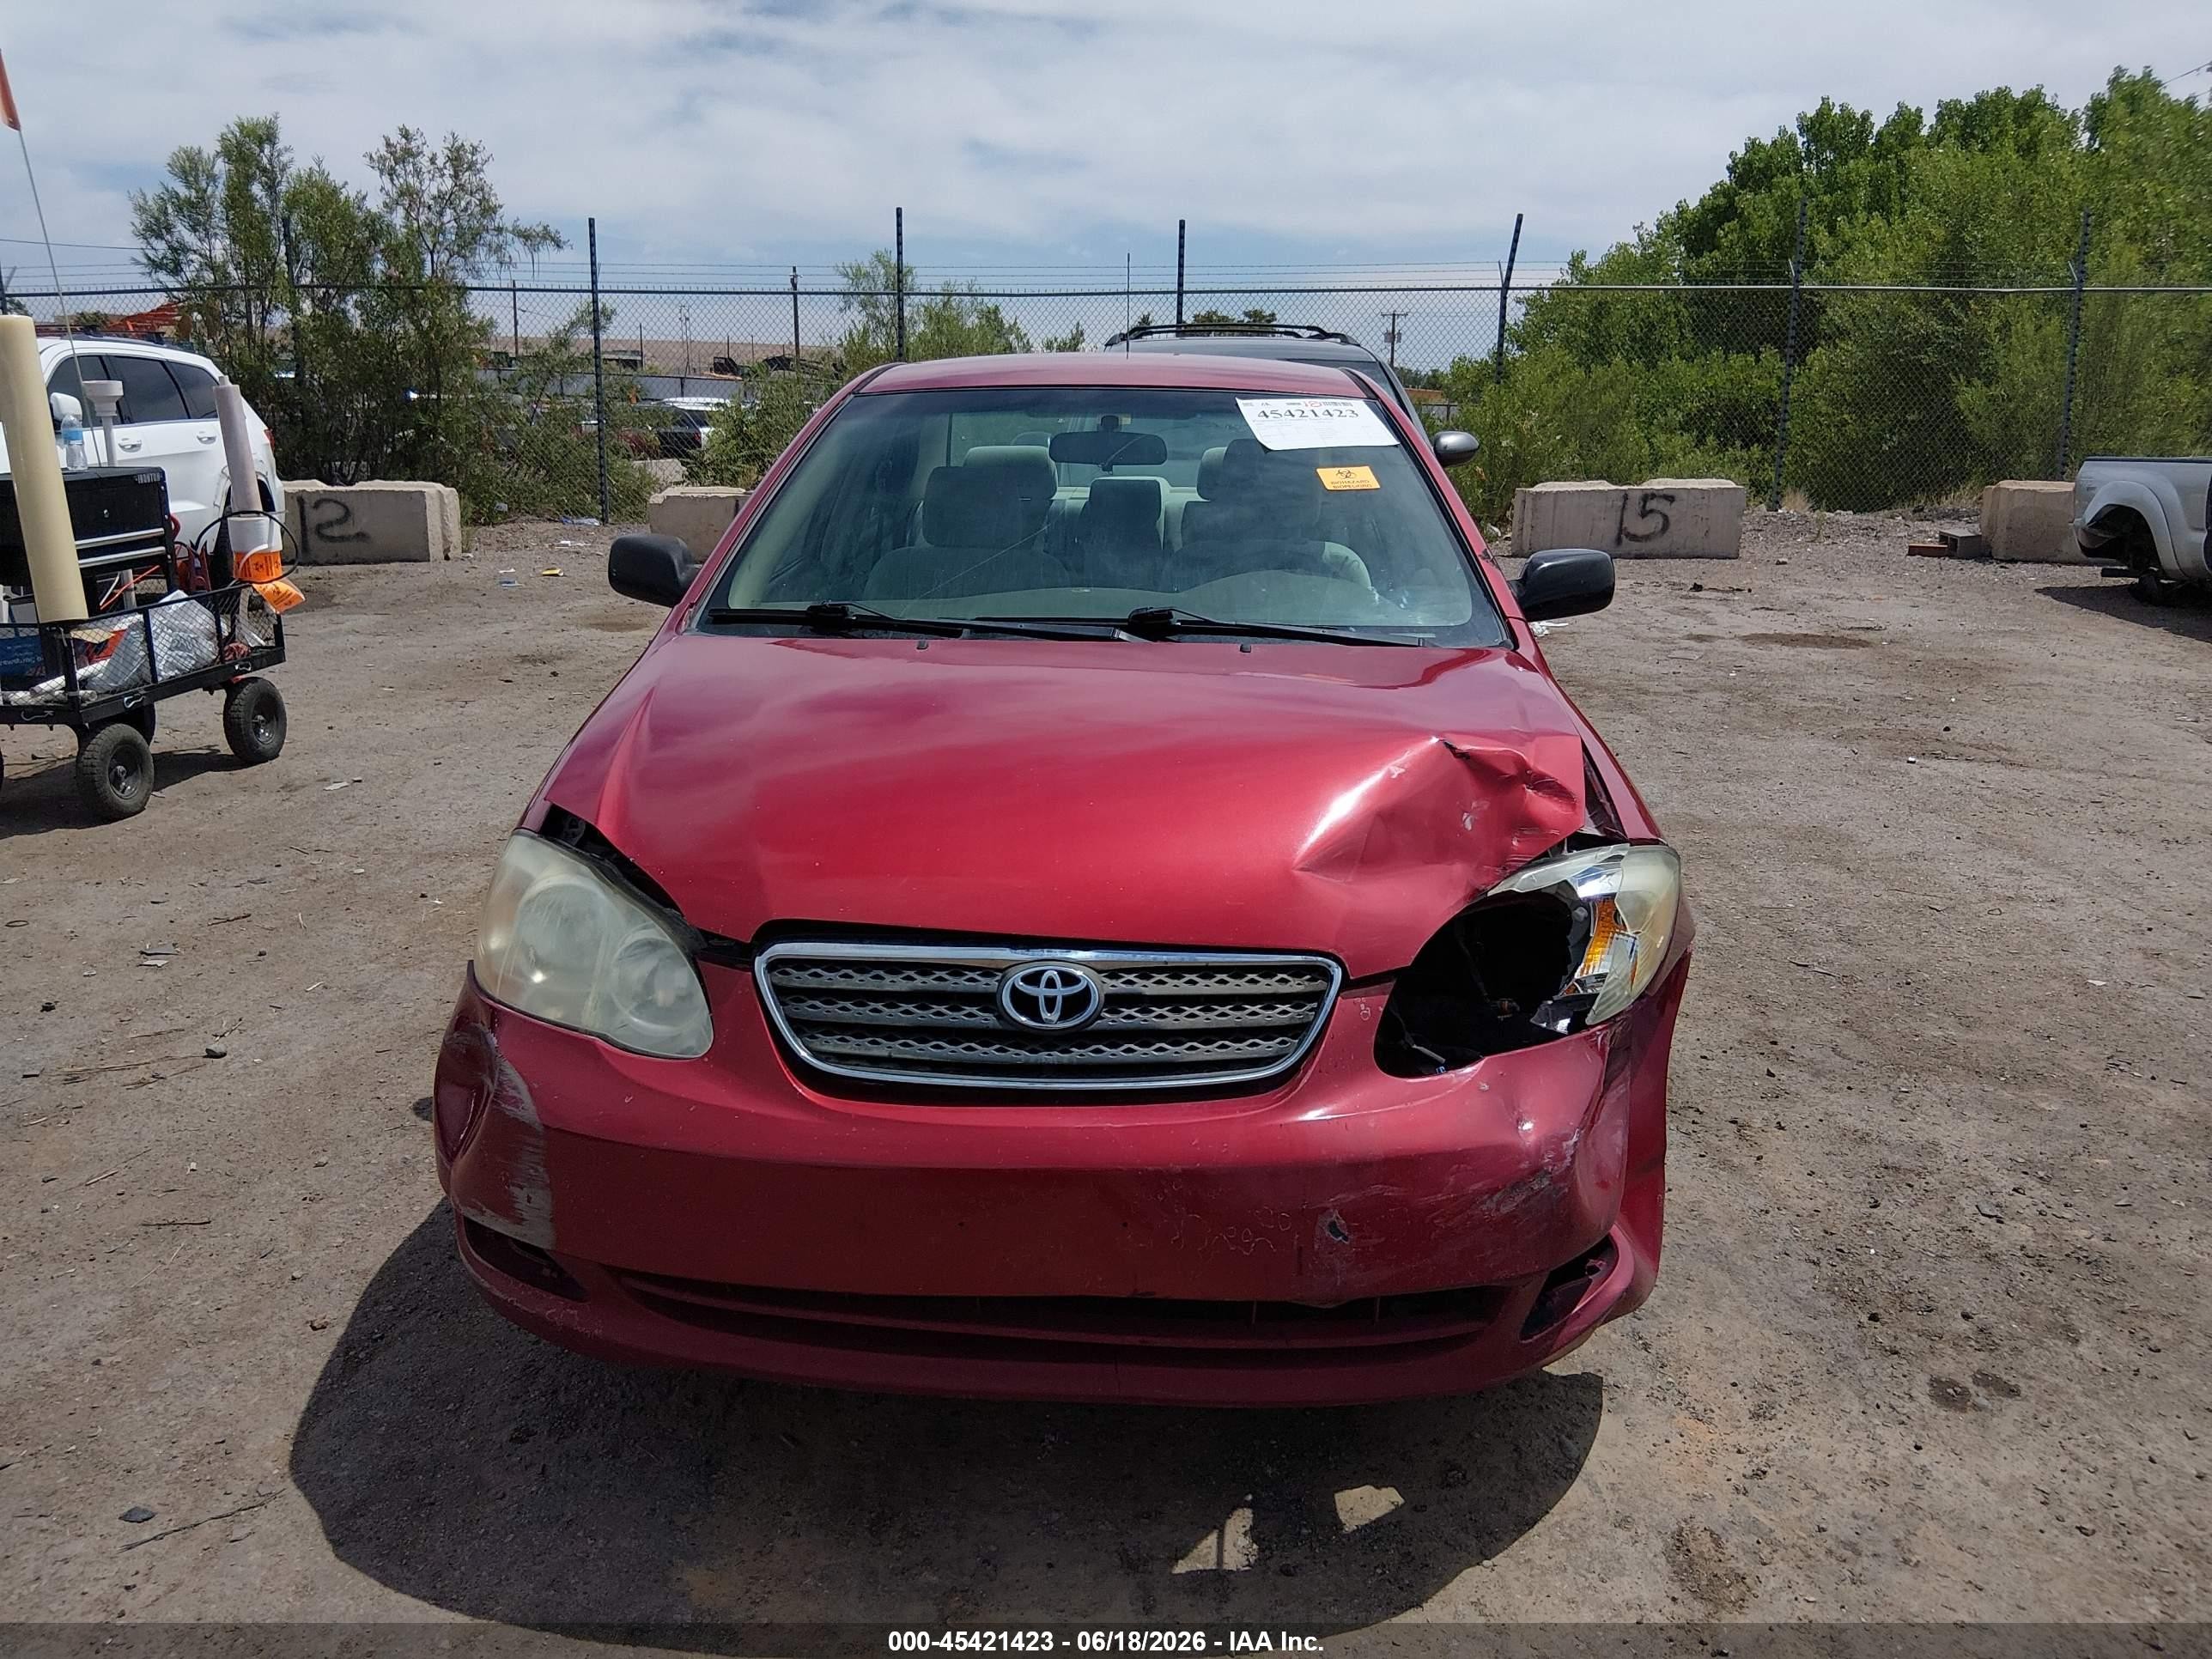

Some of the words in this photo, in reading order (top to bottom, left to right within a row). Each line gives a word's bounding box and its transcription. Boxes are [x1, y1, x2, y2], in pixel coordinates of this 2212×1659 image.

[1257, 409, 1359, 419] 45421423
[296, 495, 371, 554] 12
[1616, 492, 1676, 546] 15
